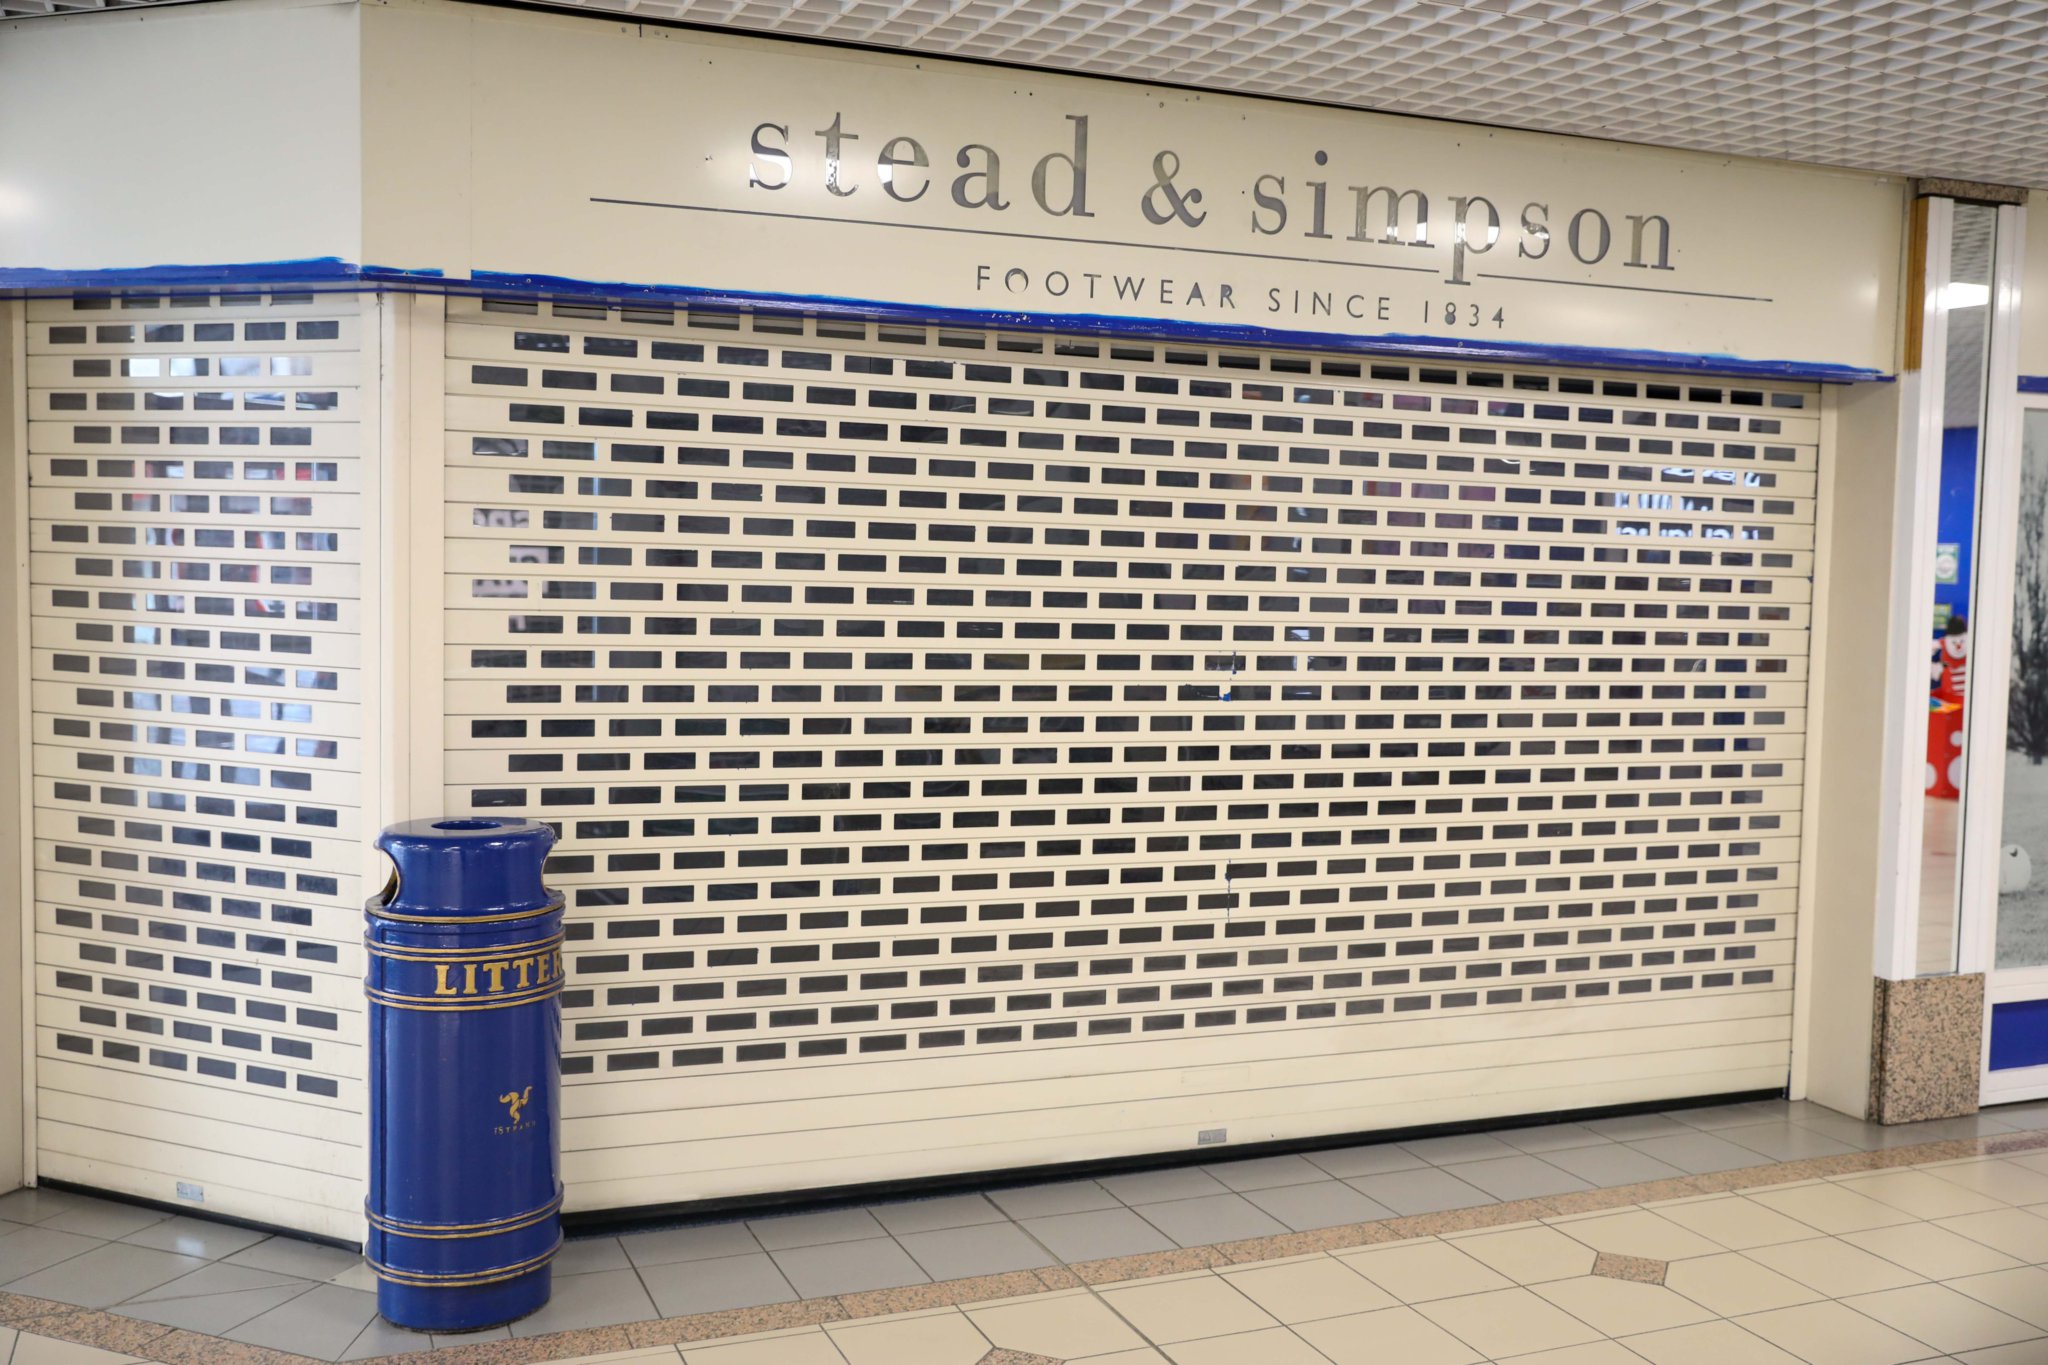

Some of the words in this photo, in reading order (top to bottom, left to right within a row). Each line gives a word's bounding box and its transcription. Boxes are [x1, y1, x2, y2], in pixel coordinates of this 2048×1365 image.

[749, 111, 1095, 218] stead
[1140, 149, 1208, 229] &
[1250, 149, 1676, 286] simpson
[976, 265, 1236, 309] FOOTWEAR
[1267, 287, 1391, 321] SINCE
[1423, 299, 1505, 329] 1834
[434, 950, 561, 995] LITTER
